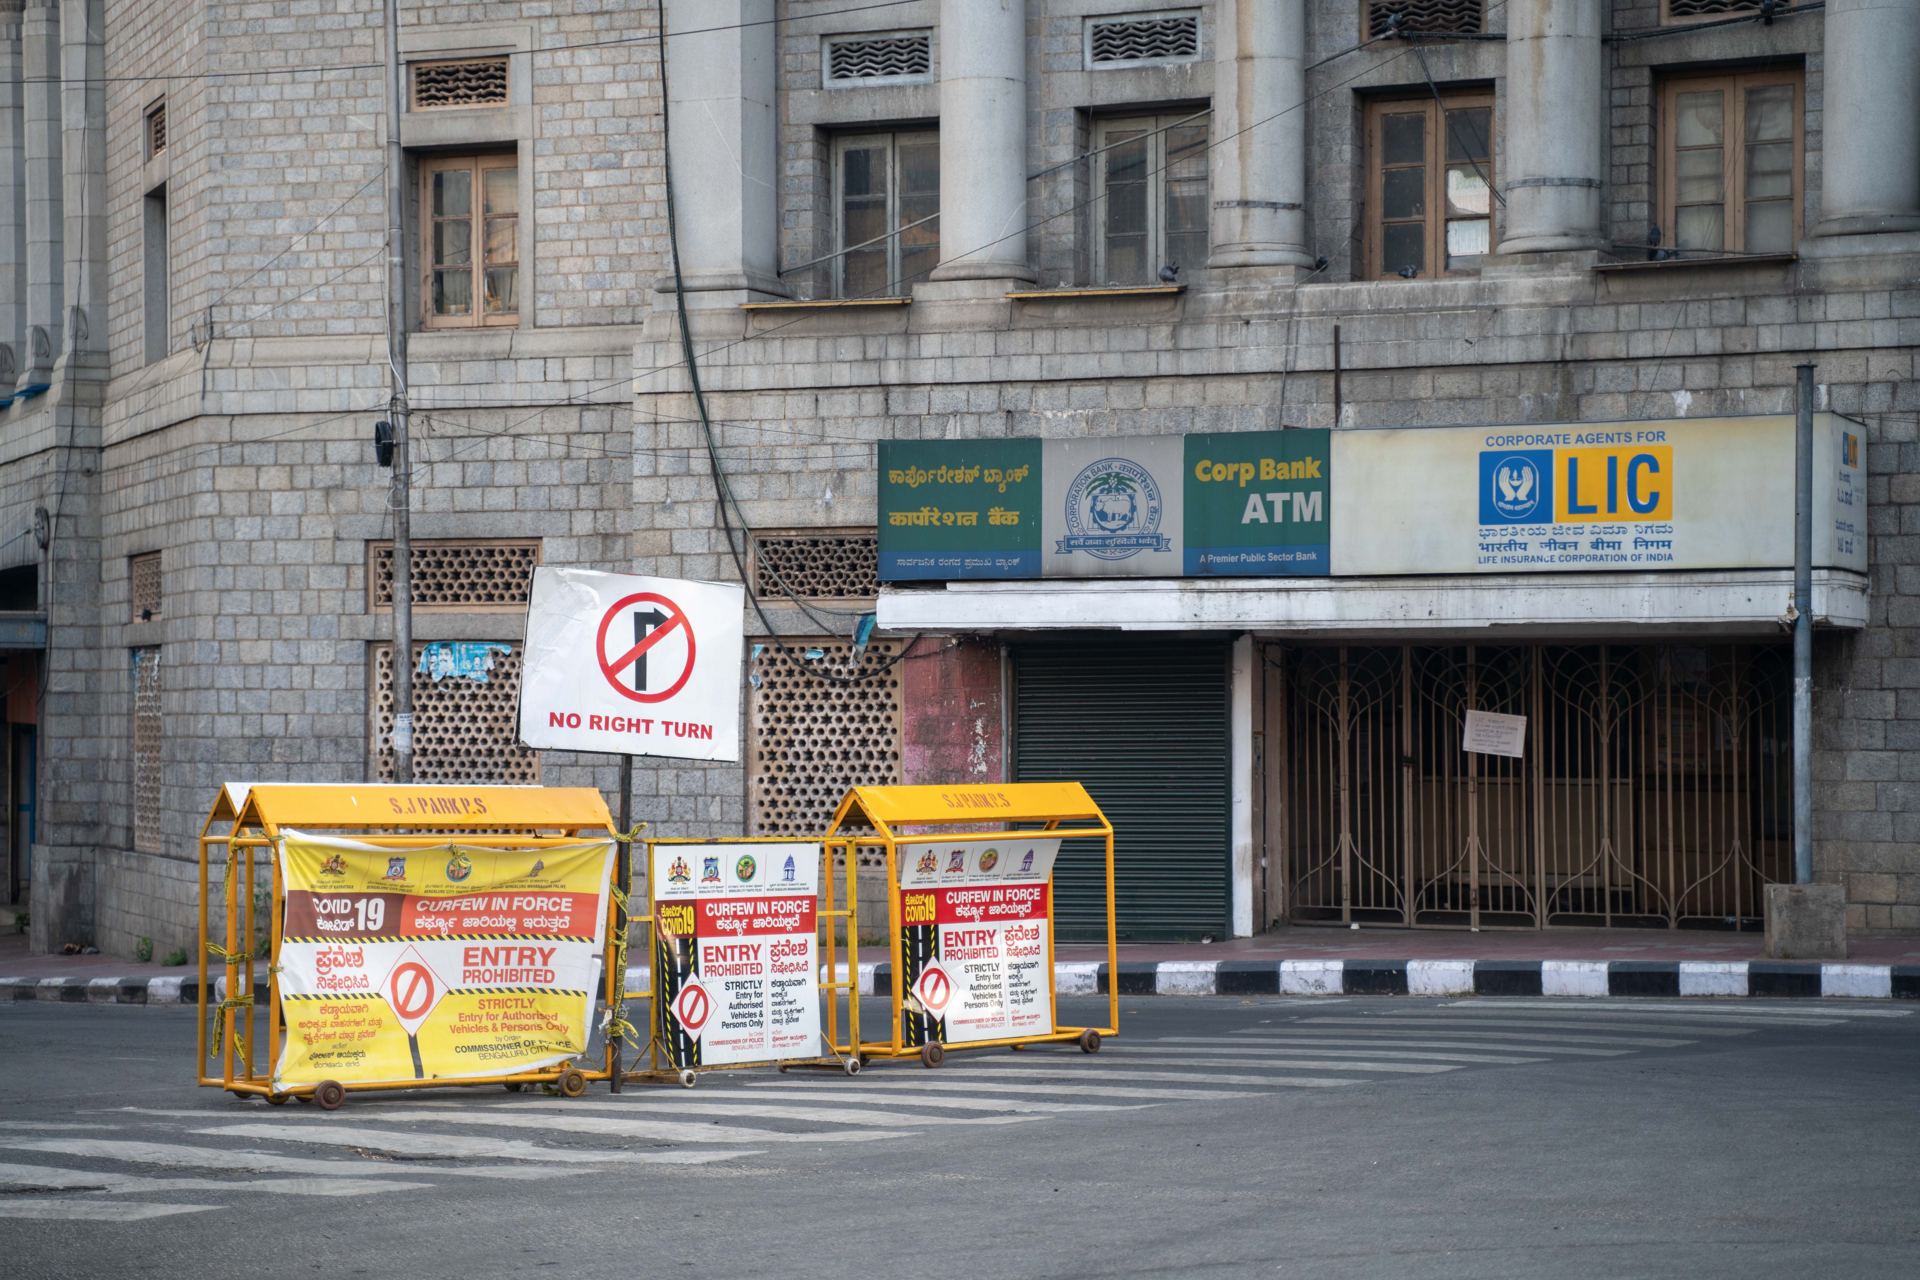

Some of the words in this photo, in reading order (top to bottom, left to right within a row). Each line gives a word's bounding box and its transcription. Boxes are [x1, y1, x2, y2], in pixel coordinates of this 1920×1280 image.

[1486, 434, 1571, 447] CORPORATE
[1575, 432, 1632, 444] AGENTS
[1637, 431, 1666, 442] FOR
[984, 464, 1029, 493] ಬ್ಯಾಂಕ್
[1195, 460, 1255, 487] Corp
[1260, 457, 1322, 480] Bank
[1568, 454, 1660, 514] LIC
[1070, 474, 1092, 529] CORPORATION
[1090, 463, 1113, 477] BANK
[988, 506, 1019, 525] बैंक
[1241, 491, 1322, 524] ATM
[1479, 525, 1546, 539] ಭಾರತೀಯ
[1479, 539, 1528, 552] भारतीय
[1590, 538, 1622, 550] बीमा
[1633, 537, 1672, 550] निगम
[1200, 555, 1206, 563] A
[1208, 554, 1238, 563] Premier
[1241, 553, 1265, 562] Public
[1268, 552, 1294, 561] Sector
[1296, 552, 1317, 560] Bank
[1479, 556, 1497, 564] LIFE
[1501, 555, 1555, 563] INSURANCE
[1559, 554, 1628, 563] CORPORATION
[1631, 554, 1643, 562] OF
[1646, 553, 1673, 561] INDIA
[549, 712, 581, 728] NO
[589, 715, 654, 734] RIGHT
[662, 721, 712, 740] TURN
[946, 891, 991, 904] CURFEW
[993, 890, 1003, 902] IN
[1006, 888, 1040, 901] FORCE
[313, 898, 351, 914] COVID
[416, 898, 489, 912] CURFEW
[491, 898, 504, 911] IN
[513, 897, 572, 912] FORCE
[706, 903, 754, 917] CURFEW
[757, 902, 768, 914] IN
[771, 900, 810, 913] FORCE
[924, 894, 935, 921] 19
[355, 898, 385, 931] 19
[682, 906, 694, 935] 19
[905, 906, 925, 922] COVID
[463, 916, 517, 931] ಜಾರಿಯಲ್ಲಿ
[523, 916, 570, 932] ಇರುತ್ತದೆ
[662, 918, 683, 936] COVID
[944, 929, 997, 948] ENTRY
[1004, 924, 1040, 946] ಪ್ರವೇಶ
[463, 947, 557, 967] ENTRY
[703, 944, 762, 963] ENTRY
[770, 939, 808, 962] ಪ್ರವೇಶ
[945, 947, 998, 961] PROHIBITED
[316, 945, 364, 975] ಪ್ರವೇಶ
[964, 963, 1000, 973] STRICTLY
[463, 969, 555, 984] PROHIBITED
[704, 963, 763, 977] PROHIBITED
[975, 974, 991, 982] Entry
[317, 974, 369, 991] ನಿಷೇಧಿಸಿದೆ
[725, 980, 763, 991] STRICTLY
[970, 982, 1002, 991] Authorised
[478, 998, 535, 1010] STRICTLY
[736, 992, 752, 1000] Entry
[972, 992, 997, 1000] Vehicles
[990, 1000, 1003, 1008] Only
[729, 1001, 763, 1010] Authorised
[459, 1013, 484, 1023] Entry
[486, 1012, 499, 1021] for
[502, 1011, 558, 1021] Authorised
[731, 1011, 757, 1019] Vehicles
[450, 1024, 489, 1034] Vehicles
[492, 1024, 498, 1032] &
[501, 1023, 542, 1032] Persons
[546, 1022, 569, 1034] Only
[722, 1021, 747, 1029] Persons
[749, 1020, 763, 1029] Only
[455, 1042, 521, 1053] COMMISSIONER
[523, 1040, 536, 1048] OF
[478, 1049, 528, 1060] BENGALURU
[529, 1045, 550, 1055] CITY
